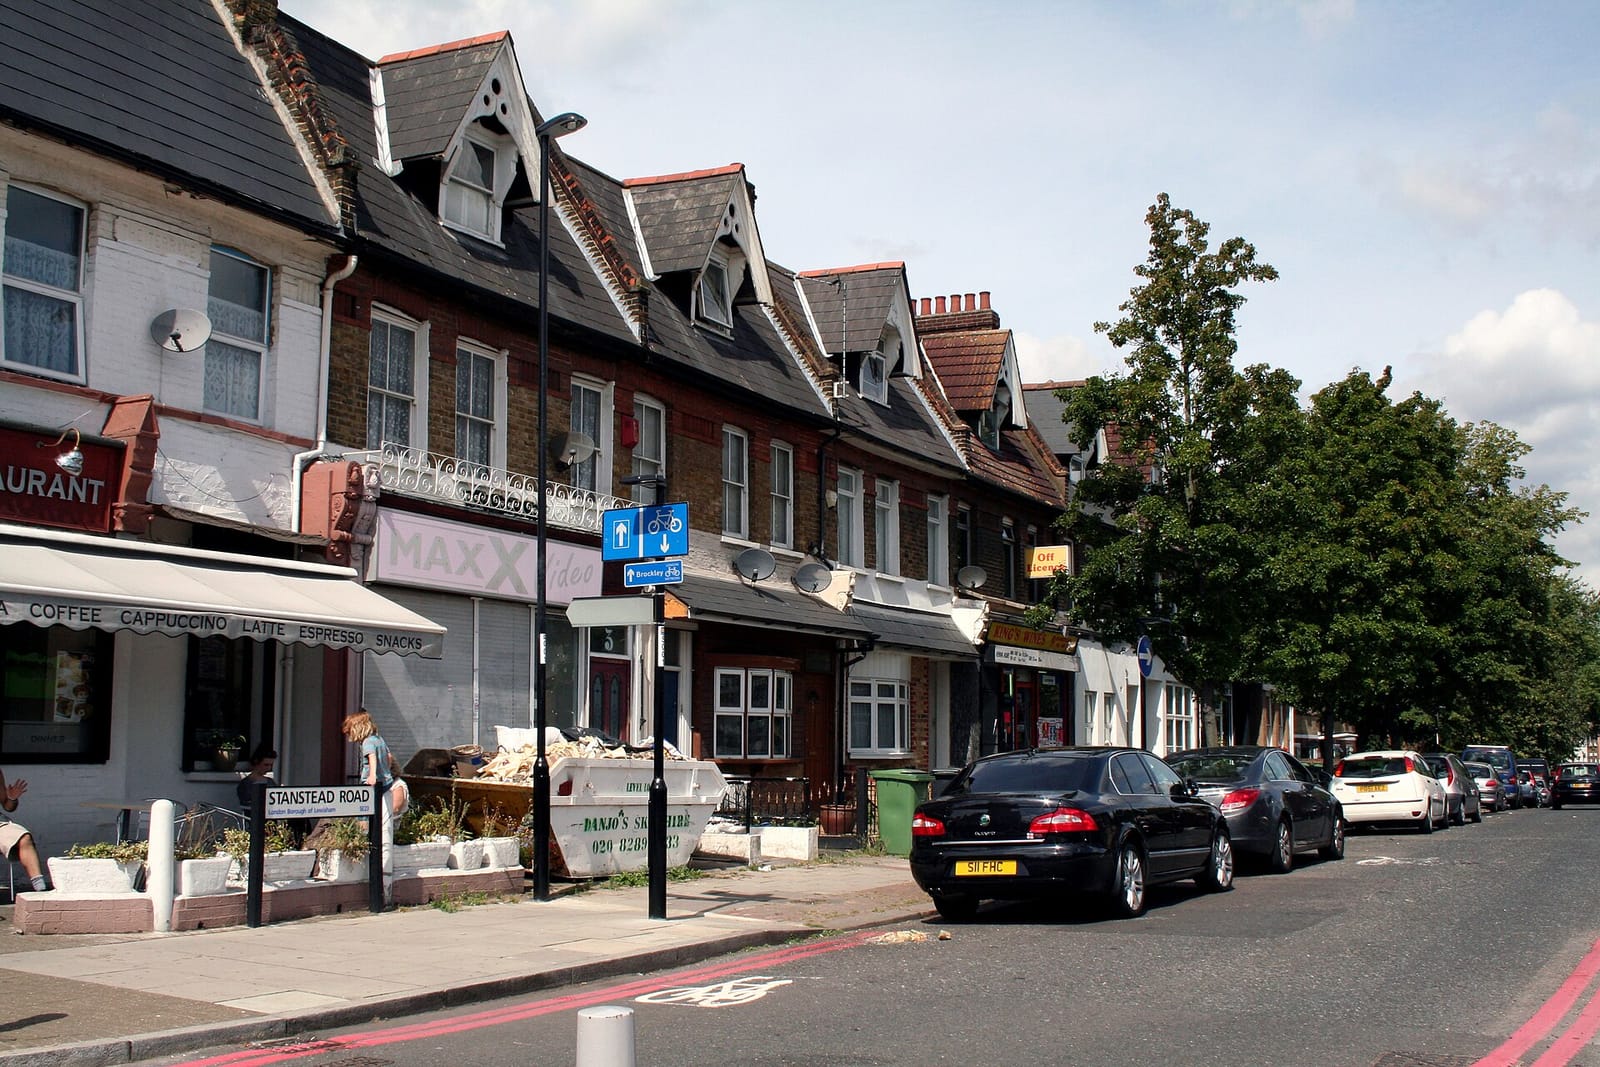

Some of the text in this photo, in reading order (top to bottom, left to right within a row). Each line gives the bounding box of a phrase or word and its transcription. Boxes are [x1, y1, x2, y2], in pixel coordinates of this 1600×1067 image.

[389, 532, 593, 595] MAXX ideo
[1037, 552, 1055, 562] Off
[636, 569, 664, 578] Brockley
[1026, 564, 1067, 572] Licen
[29, 603, 102, 622] COFFEE
[120, 610, 228, 630] CAPPUCCINO
[242, 619, 286, 636] LATTE
[300, 626, 364, 645] ESPRESSO
[376, 634, 422, 649] SNACKS
[269, 789, 370, 805] STANSTEAD ROAD
[584, 810, 628, 832] DANJO'S
[592, 839, 613, 854] 020
[982, 861, 1003, 872] FHC
